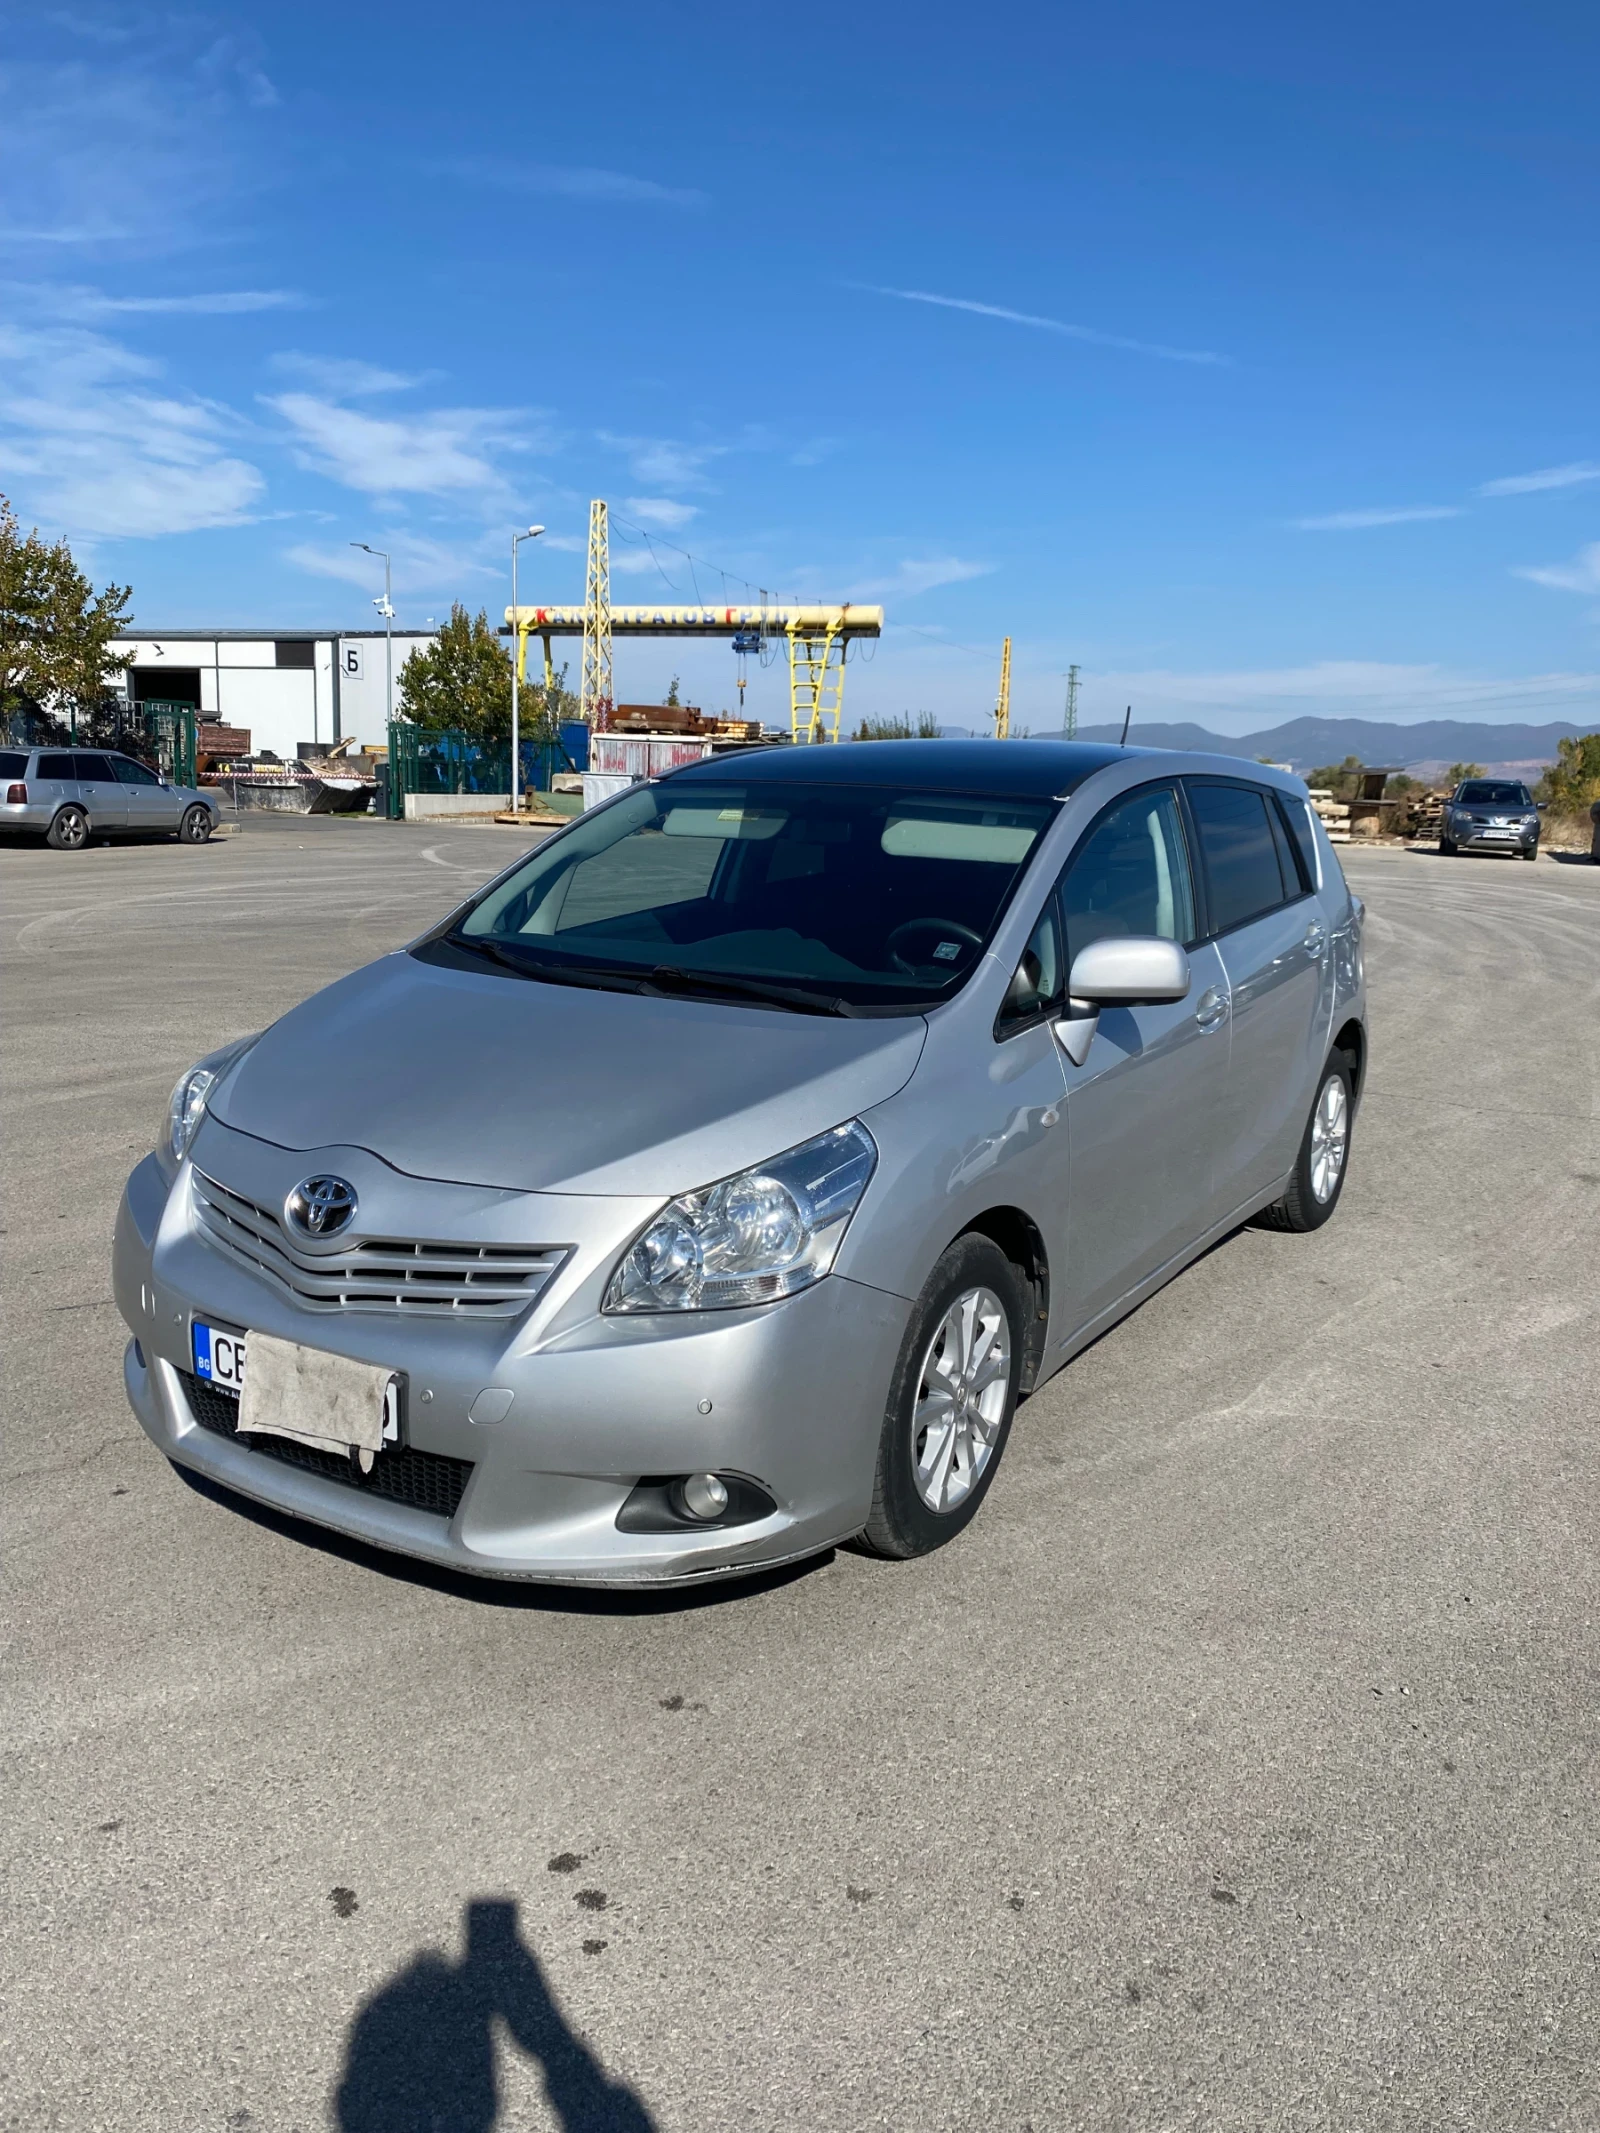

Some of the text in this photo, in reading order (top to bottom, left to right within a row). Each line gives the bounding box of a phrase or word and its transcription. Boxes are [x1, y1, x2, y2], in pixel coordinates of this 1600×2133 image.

[347, 649, 359, 673] Б
[218, 762, 231, 773] 14
[198, 1355, 210, 1371] BG
